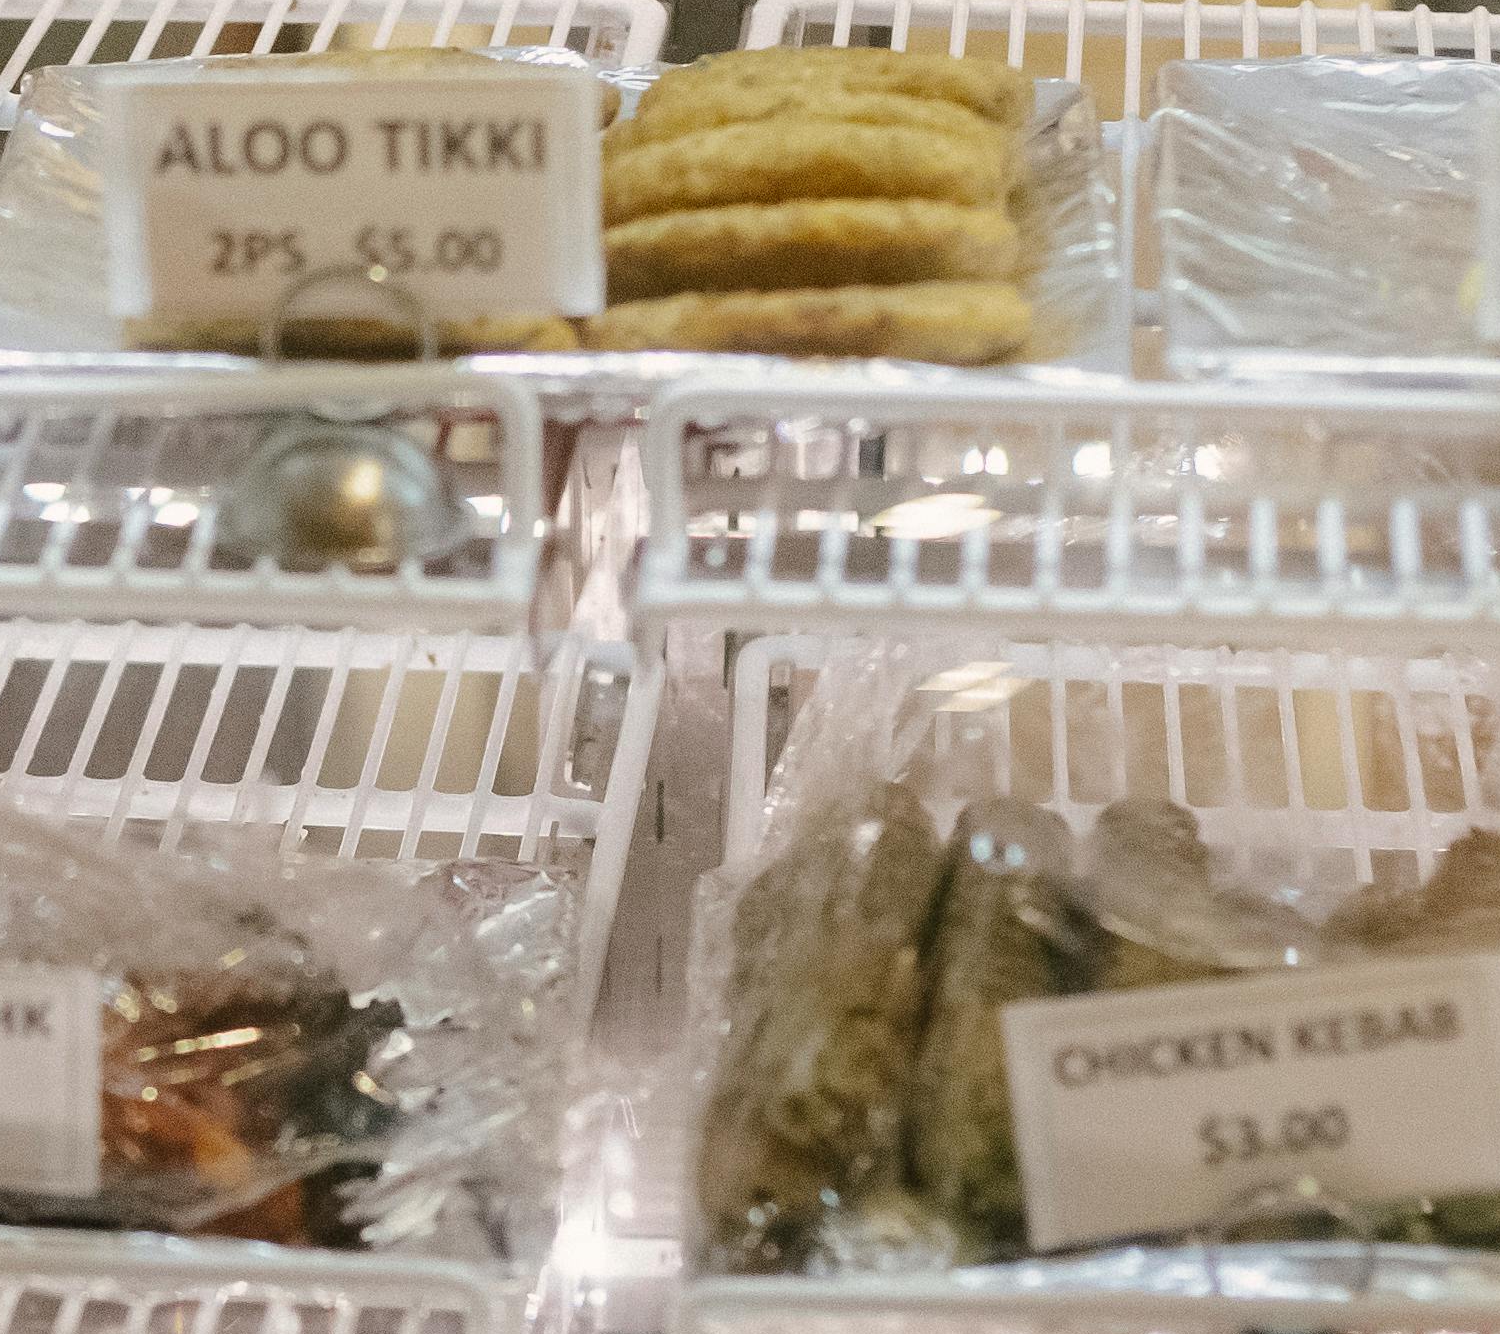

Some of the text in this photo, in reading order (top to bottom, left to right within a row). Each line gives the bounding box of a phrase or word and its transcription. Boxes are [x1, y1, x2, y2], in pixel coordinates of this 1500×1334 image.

[155, 116, 549, 174] ALOO TIKKI
[210, 225, 504, 275] 2PS $5.00
[1051, 999, 1460, 1090] CHICKEN KEBAB
[1197, 1102, 1352, 1165] $3.00
